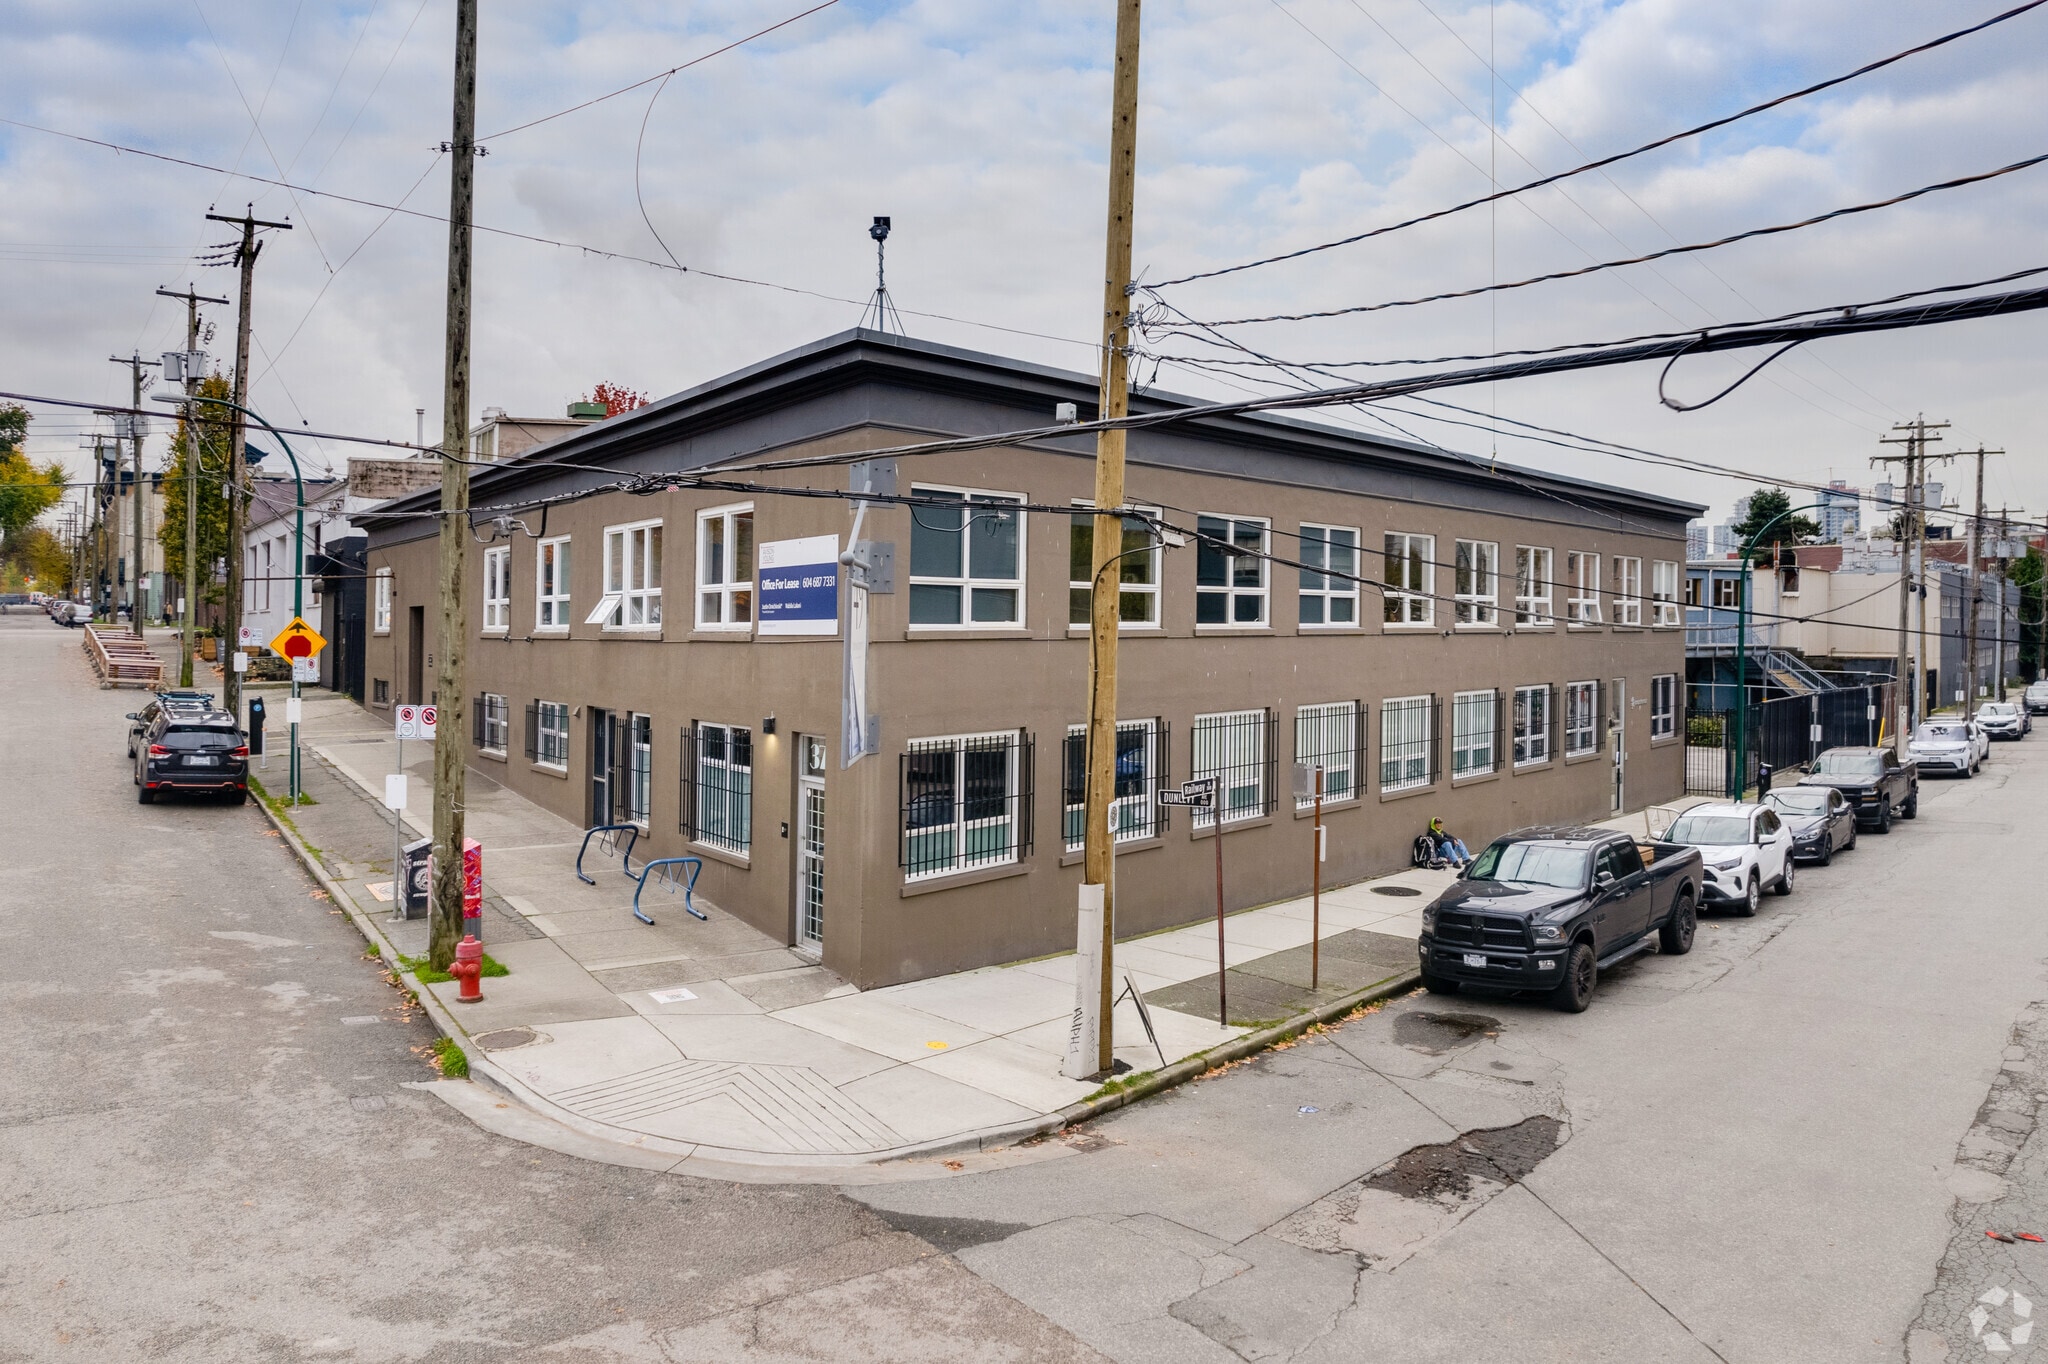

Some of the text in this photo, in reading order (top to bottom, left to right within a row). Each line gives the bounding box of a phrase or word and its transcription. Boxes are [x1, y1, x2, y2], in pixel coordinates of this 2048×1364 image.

[762, 576, 835, 590] Office For Lease 604 687 7331
[1185, 784, 1205, 795] Railway
